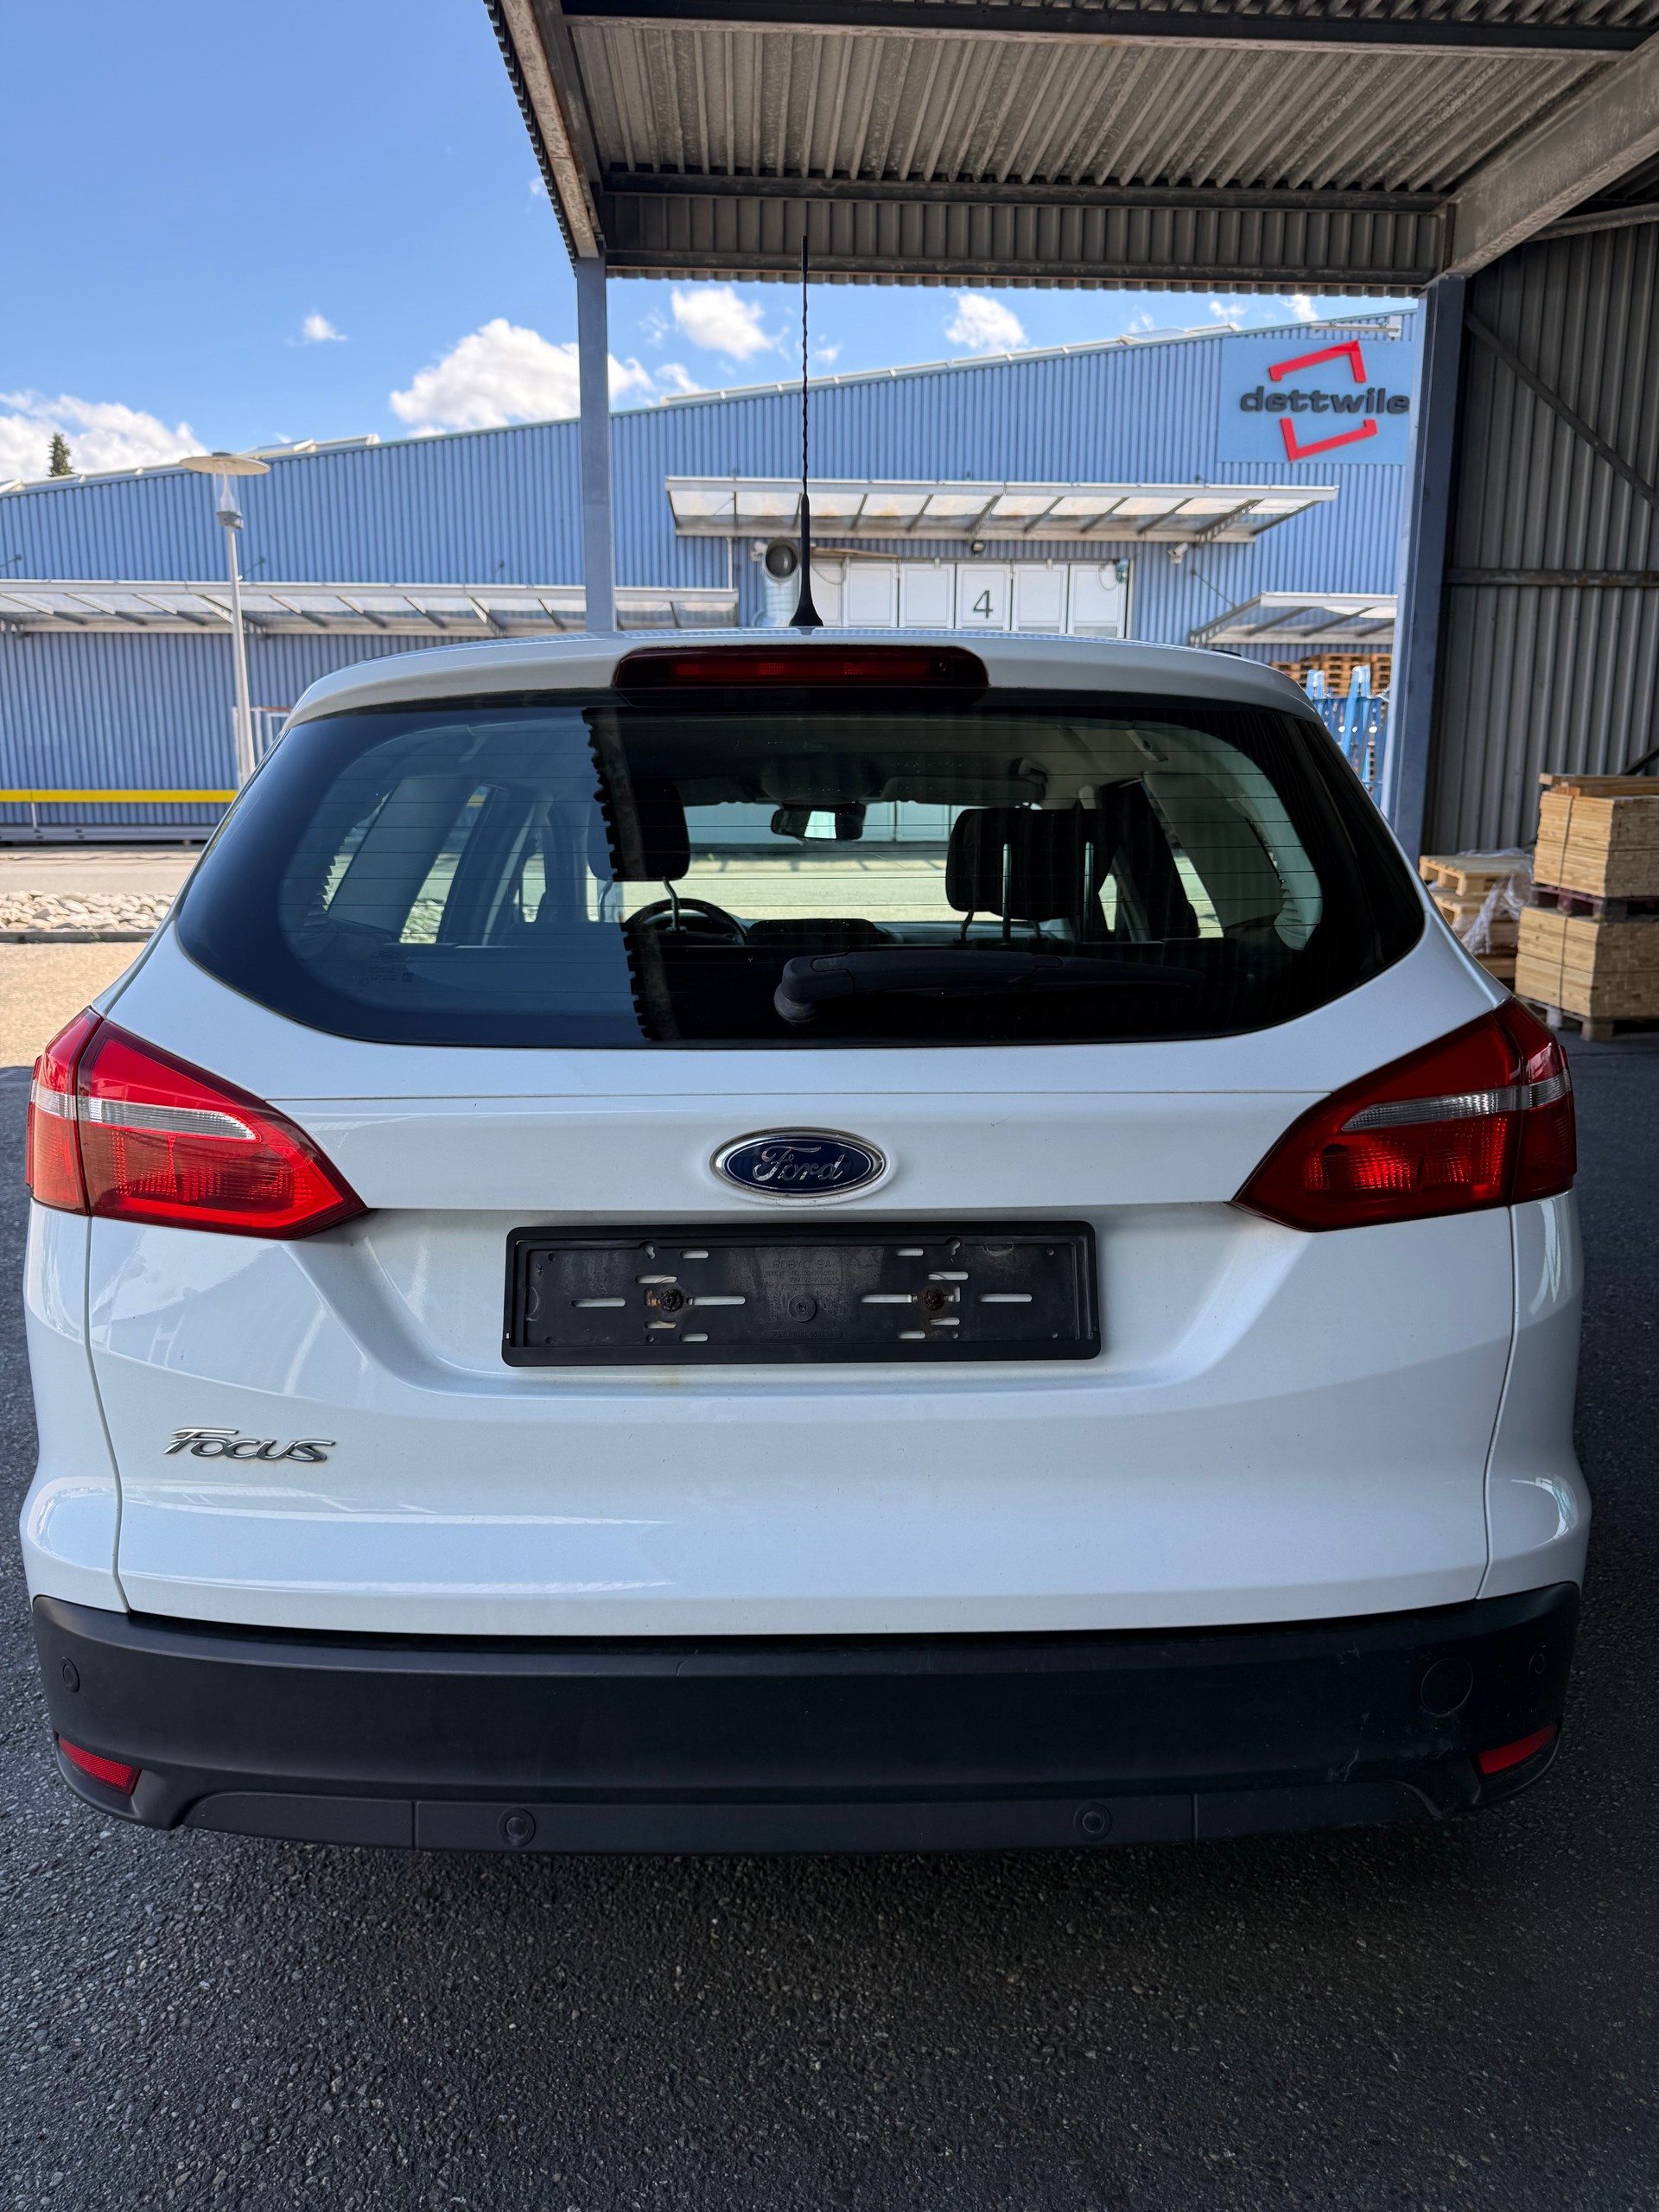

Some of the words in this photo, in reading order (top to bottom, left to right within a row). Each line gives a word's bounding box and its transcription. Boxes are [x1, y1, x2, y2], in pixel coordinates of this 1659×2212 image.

[1239, 386, 1409, 415] dettwile
[973, 589, 994, 620] 4
[752, 1145, 845, 1182] Ford
